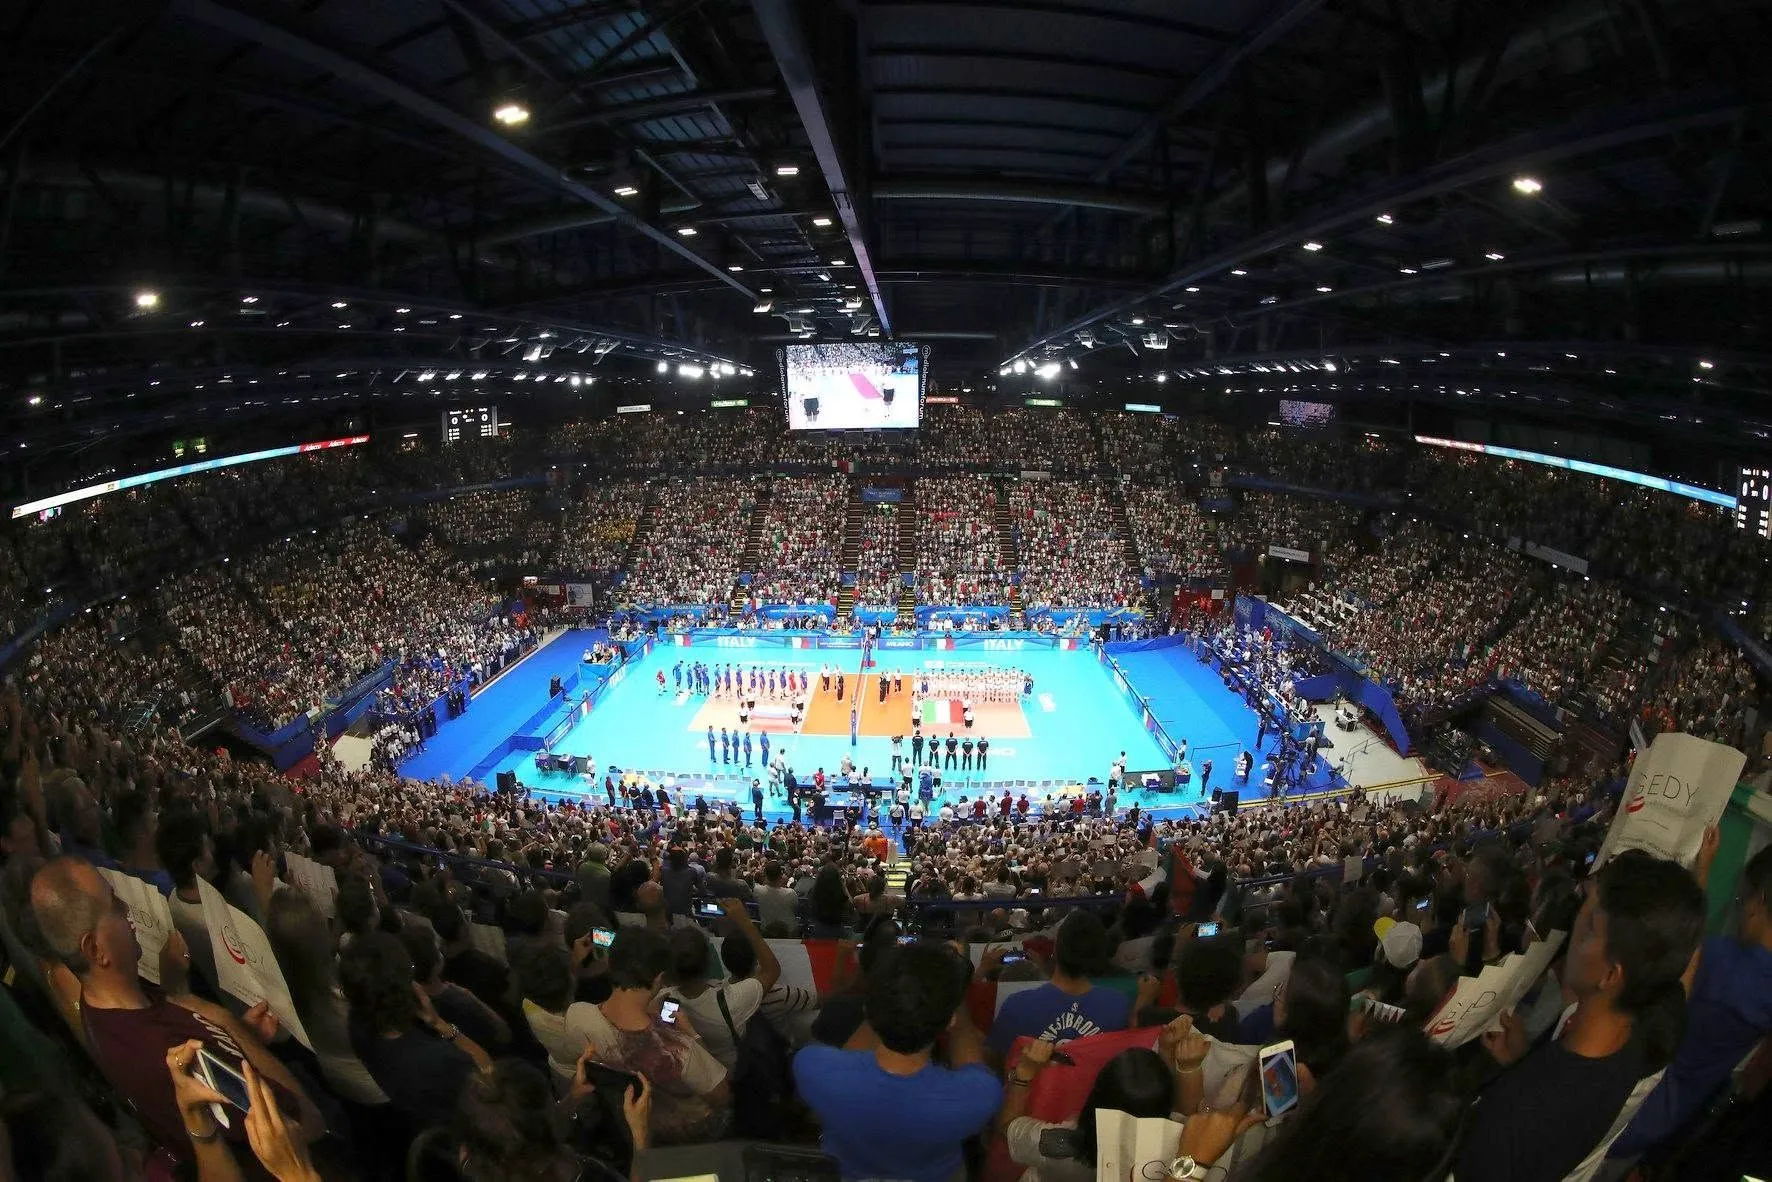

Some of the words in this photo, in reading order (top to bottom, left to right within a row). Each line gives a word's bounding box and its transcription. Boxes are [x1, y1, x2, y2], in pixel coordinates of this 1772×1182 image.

[865, 605, 898, 613] MILANO
[717, 636, 756, 648] ITALY
[984, 638, 1025, 650] ITALY
